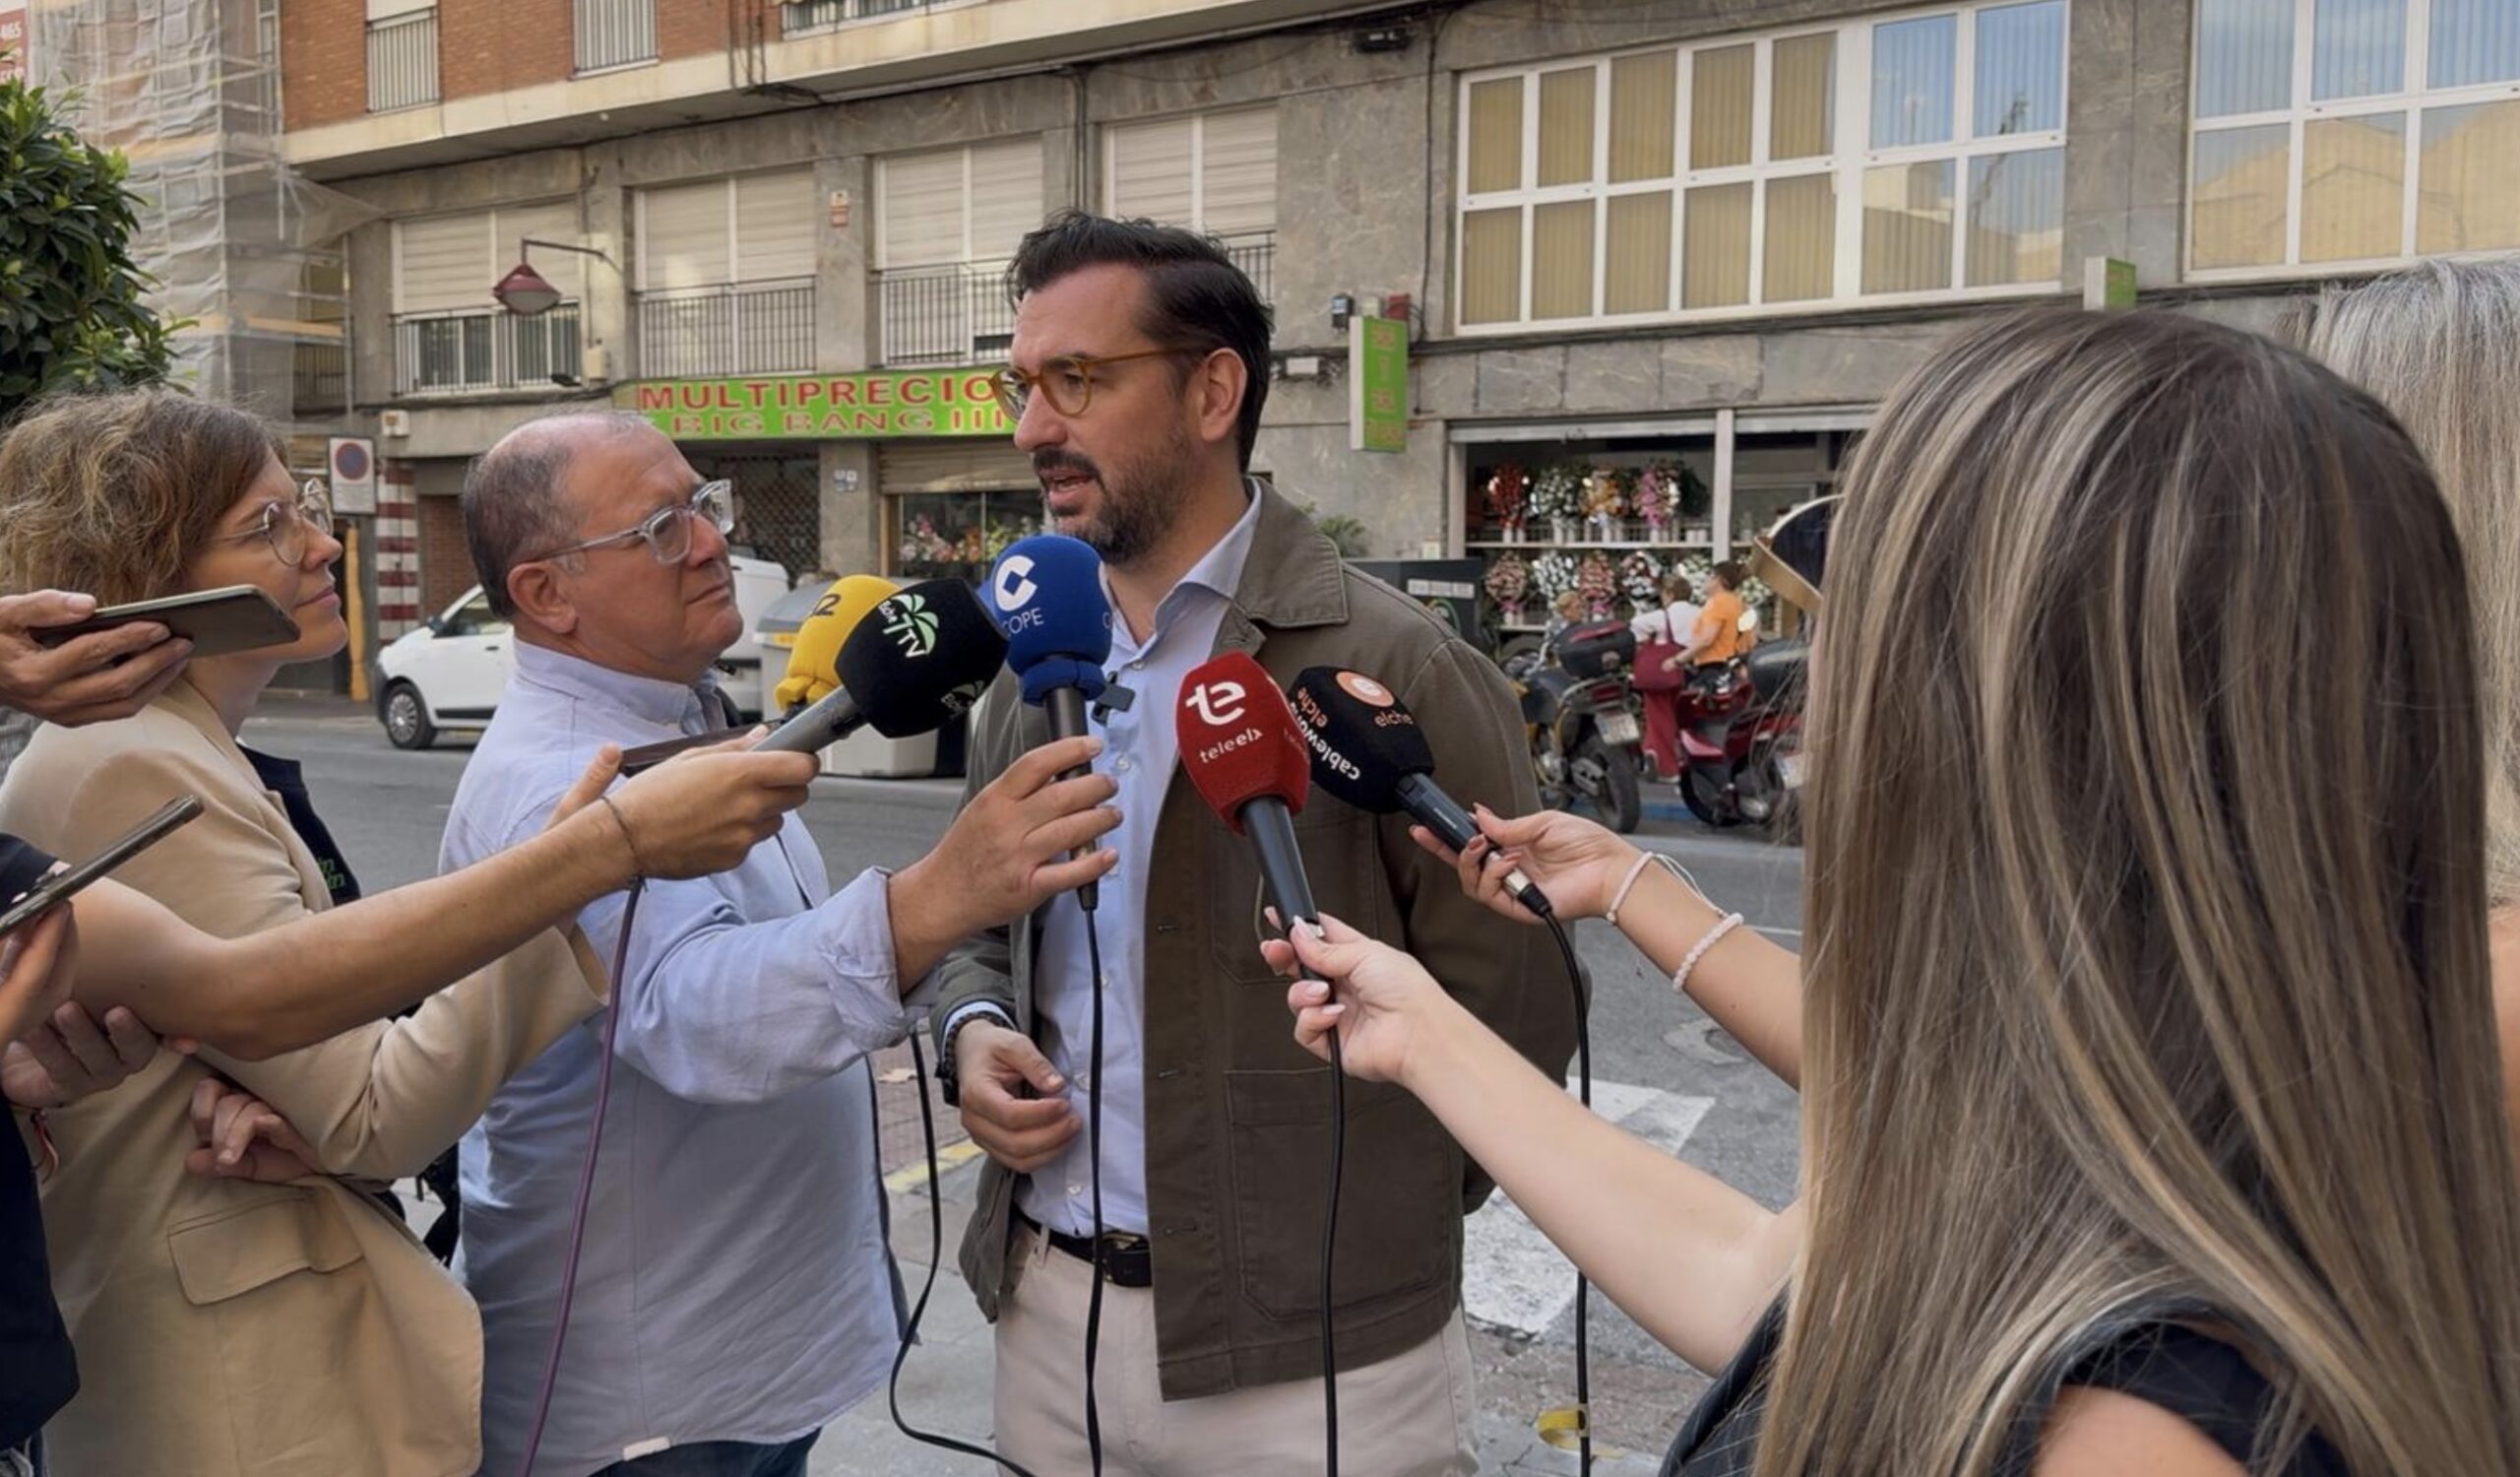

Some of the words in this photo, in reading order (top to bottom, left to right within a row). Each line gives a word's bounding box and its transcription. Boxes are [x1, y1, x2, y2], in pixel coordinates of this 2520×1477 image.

[672, 413, 764, 435] BIG
[785, 410, 933, 433] BANG
[951, 408, 1005, 430] III
[1291, 701, 1360, 780] cablewo
